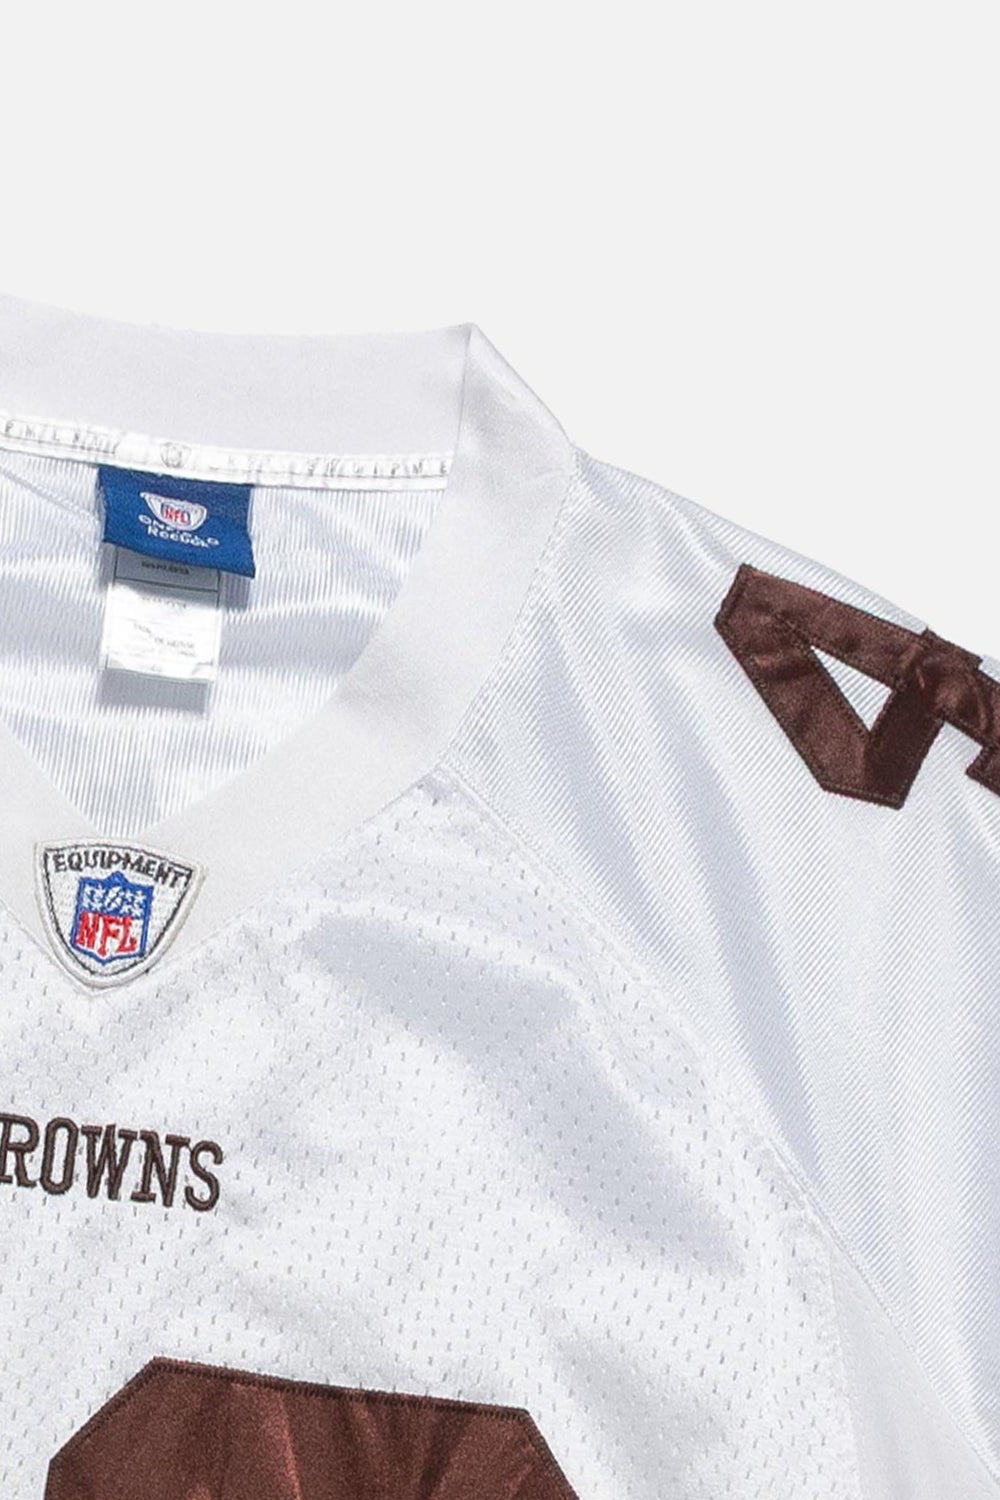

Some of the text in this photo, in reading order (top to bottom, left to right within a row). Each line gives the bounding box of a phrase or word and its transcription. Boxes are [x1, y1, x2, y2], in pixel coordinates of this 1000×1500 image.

[164, 504, 188, 525] NFL
[53, 850, 185, 888] EQUIPMENT
[76, 911, 138, 957] NFL
